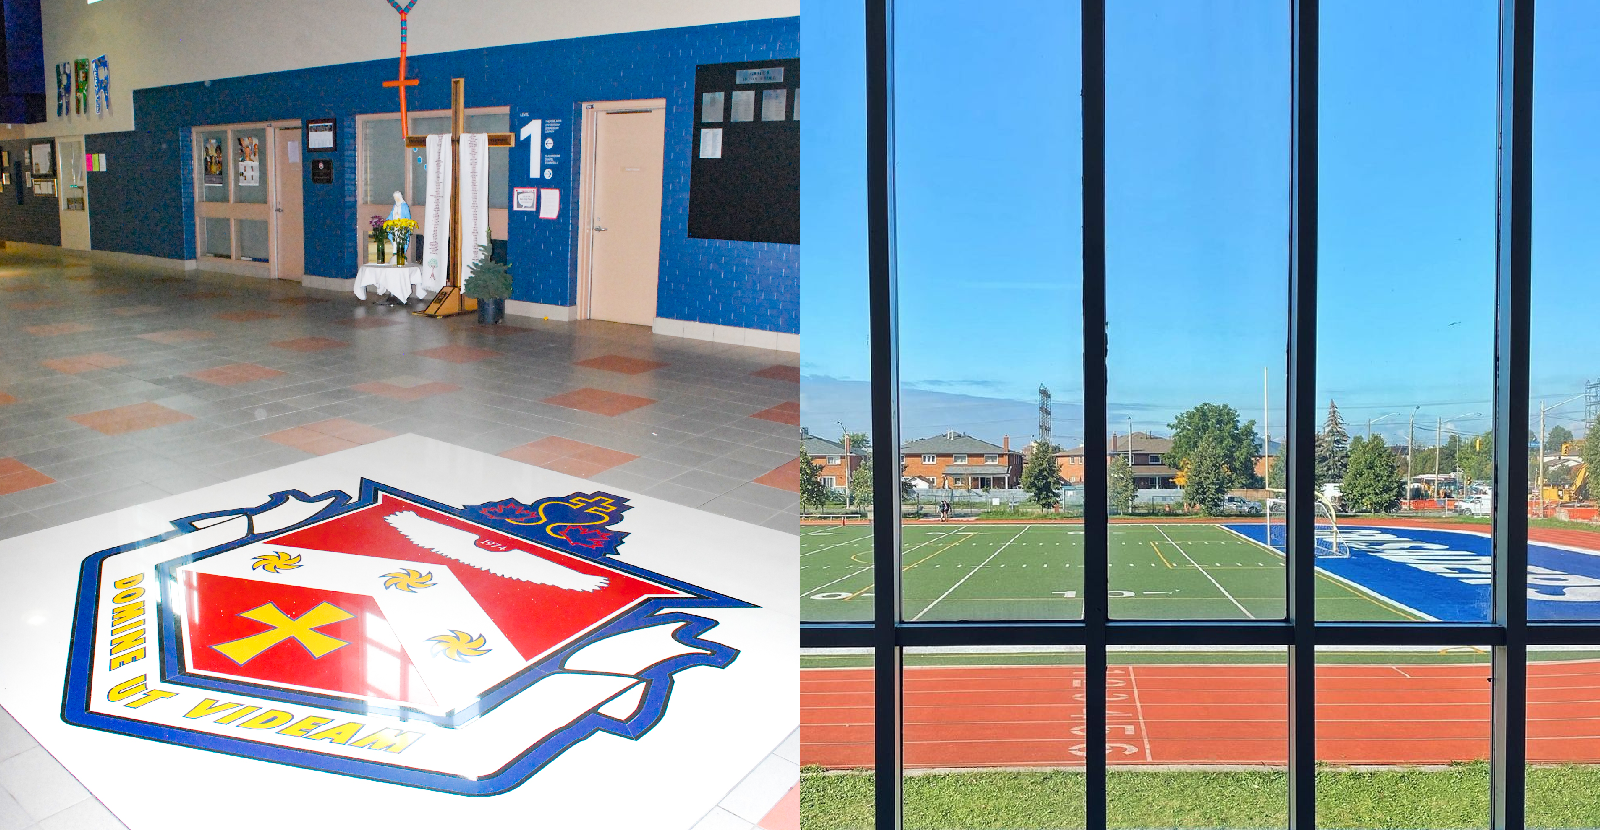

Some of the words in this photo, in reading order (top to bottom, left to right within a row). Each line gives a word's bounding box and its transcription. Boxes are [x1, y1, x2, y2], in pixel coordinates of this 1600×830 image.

[520, 119, 541, 179] 1
[109, 572, 146, 671] DOMINE
[106, 673, 179, 709] UT
[183, 698, 426, 754] VIDEAM
